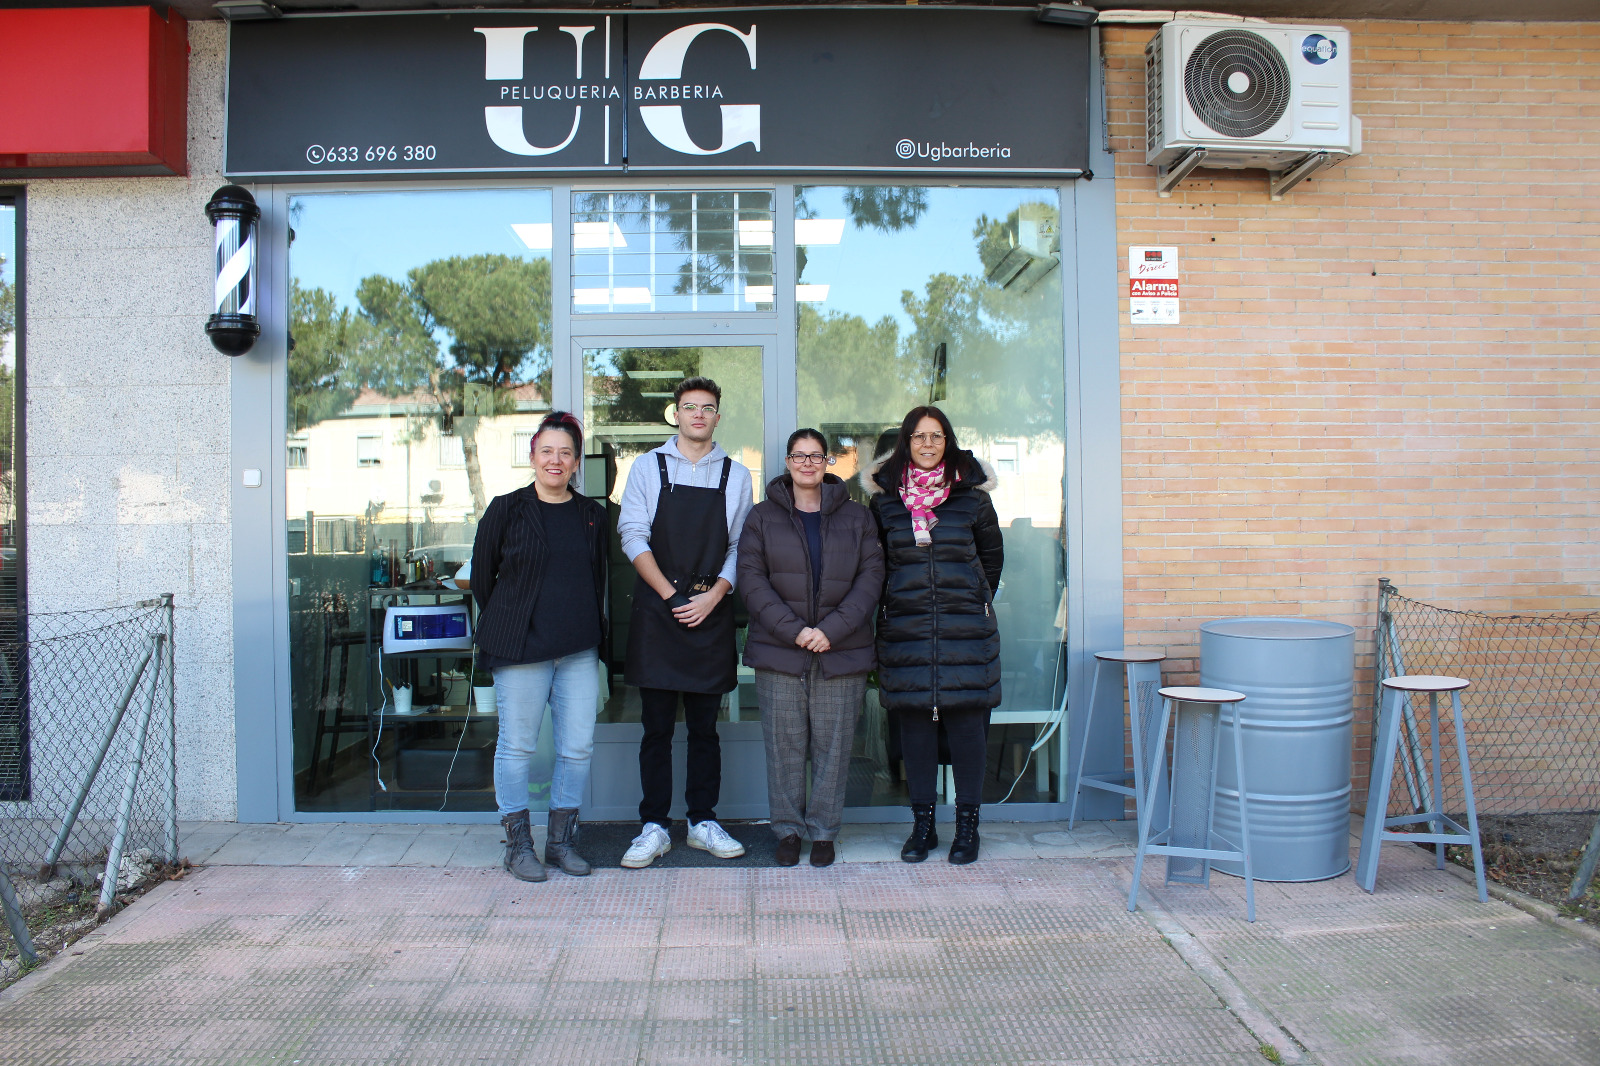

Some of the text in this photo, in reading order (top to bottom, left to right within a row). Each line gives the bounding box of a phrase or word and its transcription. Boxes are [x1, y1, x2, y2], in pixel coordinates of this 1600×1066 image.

[500, 85, 724, 101] PELUQUERIA BARBERIA
[326, 144, 437, 163] 633 696 380
[917, 141, 1011, 161] Ugbarberia
[1131, 280, 1178, 291] Alarma
